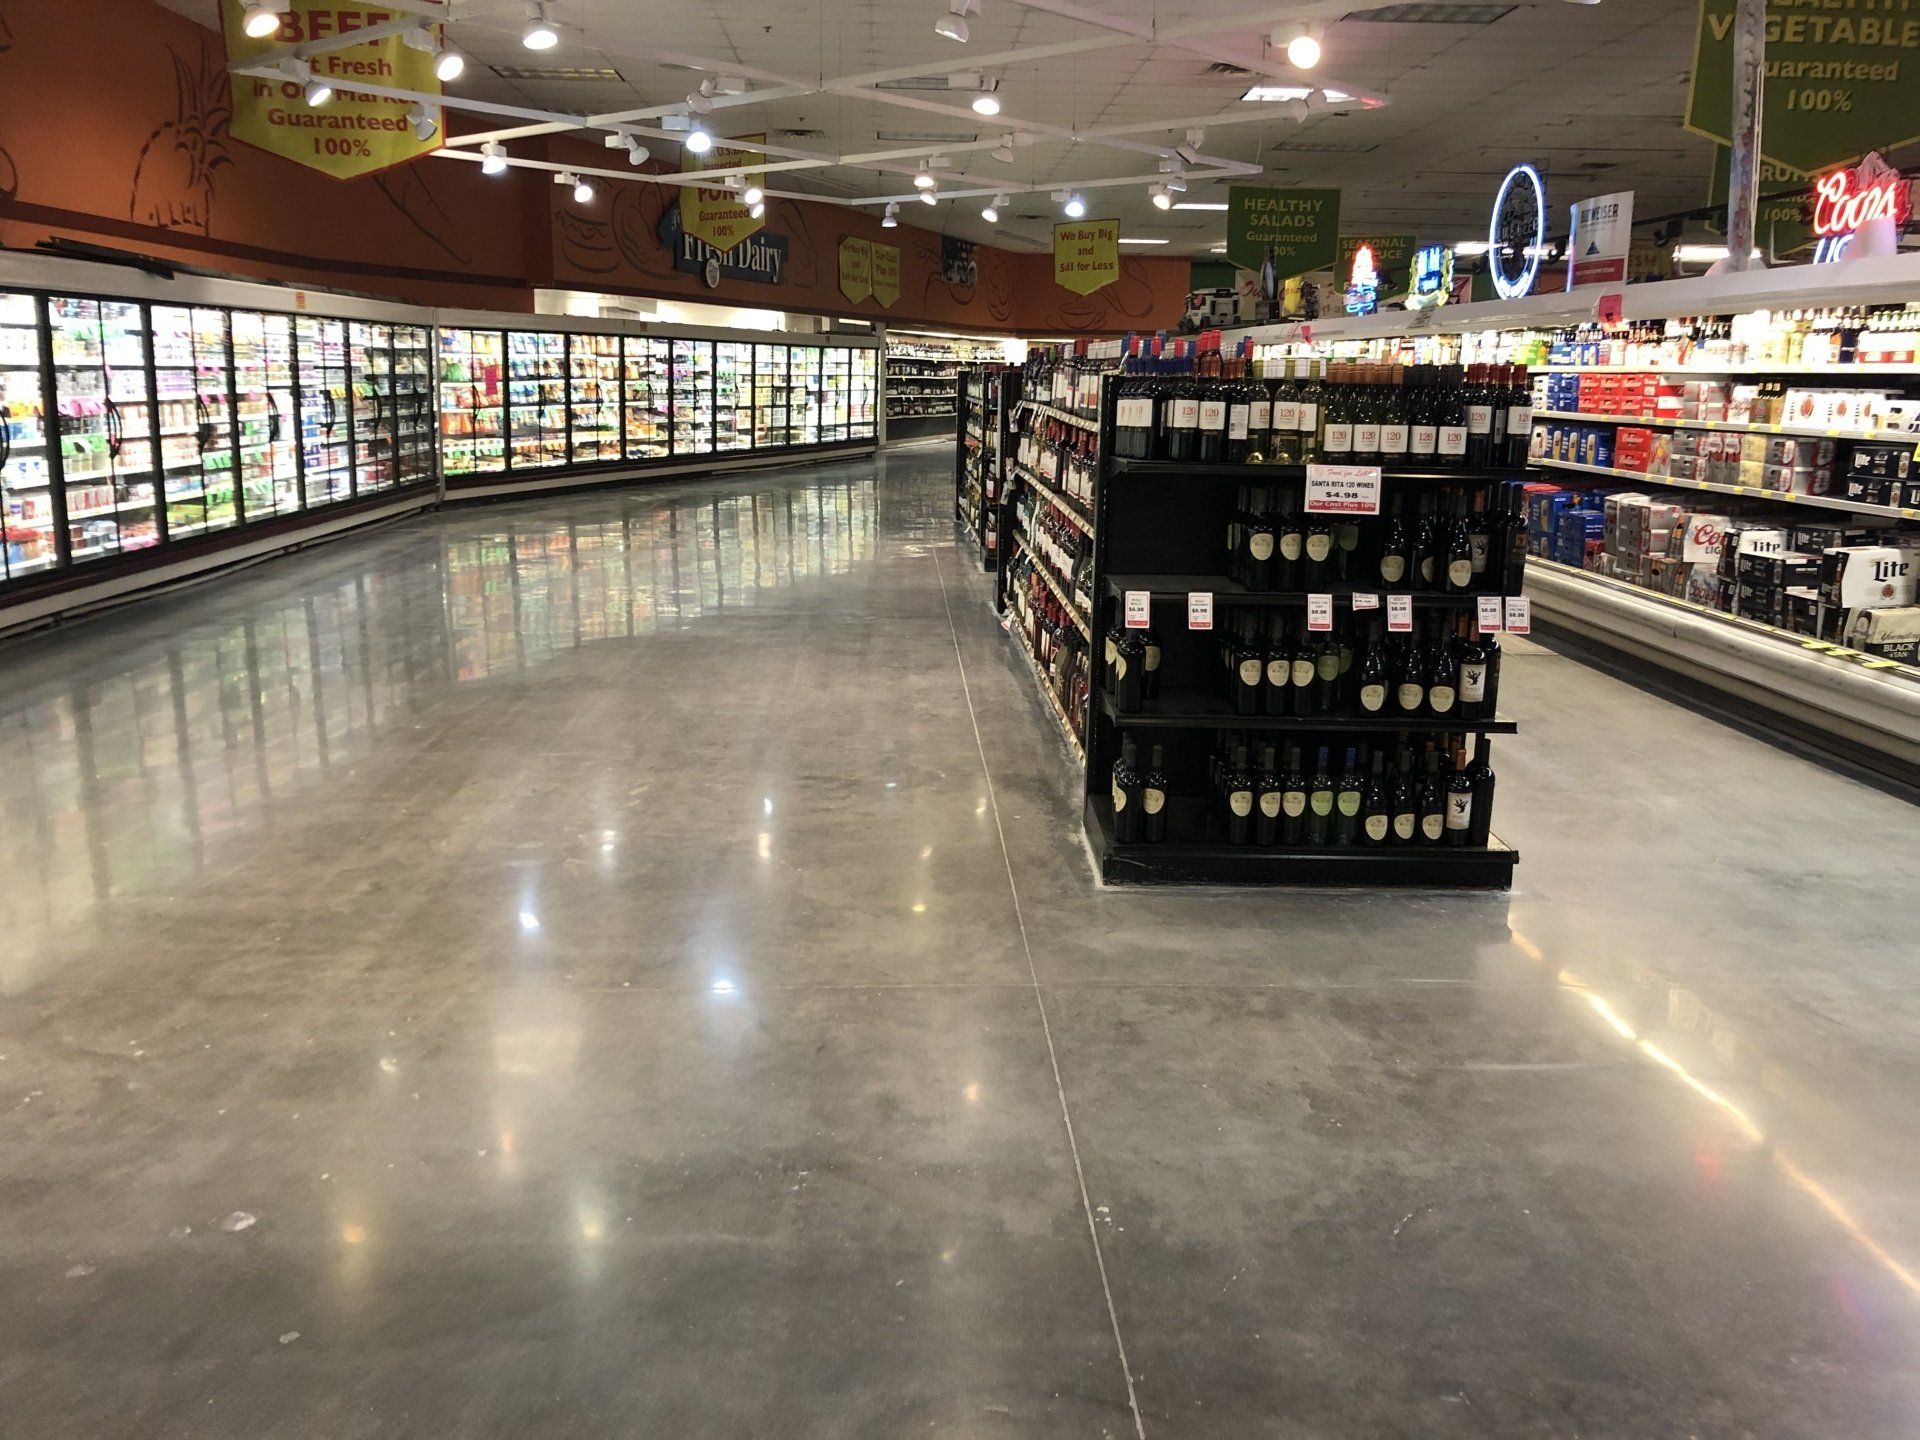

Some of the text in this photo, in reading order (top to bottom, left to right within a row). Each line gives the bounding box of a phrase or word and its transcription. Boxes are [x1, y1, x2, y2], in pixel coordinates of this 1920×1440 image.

[274, 10, 390, 47] BEEF
[1708, 14, 1920, 48] VGETABLE
[328, 56, 393, 77] Fresh
[1764, 60, 1899, 82] uaranteed
[1787, 88, 1853, 112] 100%
[267, 108, 408, 132] Guaranteed
[314, 137, 371, 158] 100%
[1243, 197, 1323, 213] HEALTHY
[1814, 171, 1898, 235] Coors
[699, 207, 749, 221] Guaranteed
[1249, 213, 1316, 228] SALADS
[713, 224, 735, 237] 100%
[1060, 228, 1113, 242] We Buy Big
[1246, 231, 1318, 243] Guaranteed
[1077, 246, 1095, 256] and
[738, 236, 782, 284] Dairy
[1077, 262, 1090, 271] for
[1092, 261, 1114, 270] Less
[1182, 406, 1197, 416] 120
[1204, 408, 1220, 418] 120
[1280, 408, 1295, 418] 120
[1470, 412, 1486, 422] 120
[1331, 430, 1347, 440] 120
[1361, 431, 1376, 440] 120
[1386, 431, 1401, 441] 120
[1418, 432, 1433, 441] 120
[1447, 432, 1462, 442] 120
[1325, 491, 1358, 499] $4.98
[1873, 561, 1910, 582] Lite
[1883, 643, 1914, 652] BLACK
